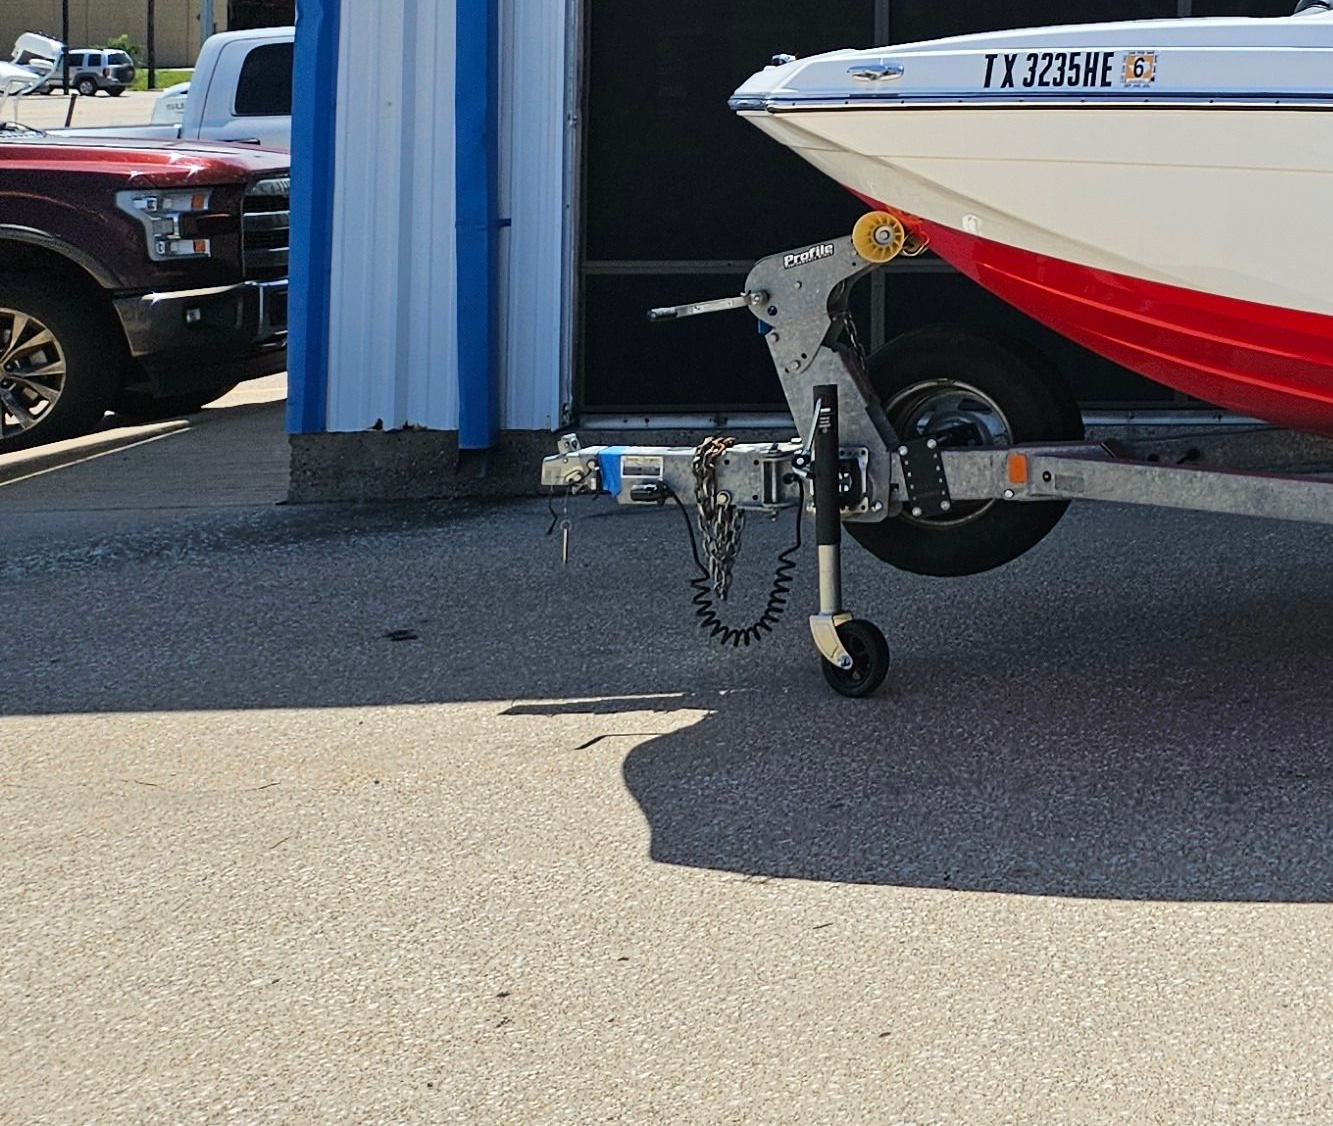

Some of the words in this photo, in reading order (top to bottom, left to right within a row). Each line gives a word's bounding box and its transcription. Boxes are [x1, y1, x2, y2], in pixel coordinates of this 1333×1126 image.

[1022, 52, 1114, 87] 3235HE
[1133, 57, 1145, 78] 6
[784, 244, 833, 268] Profile
